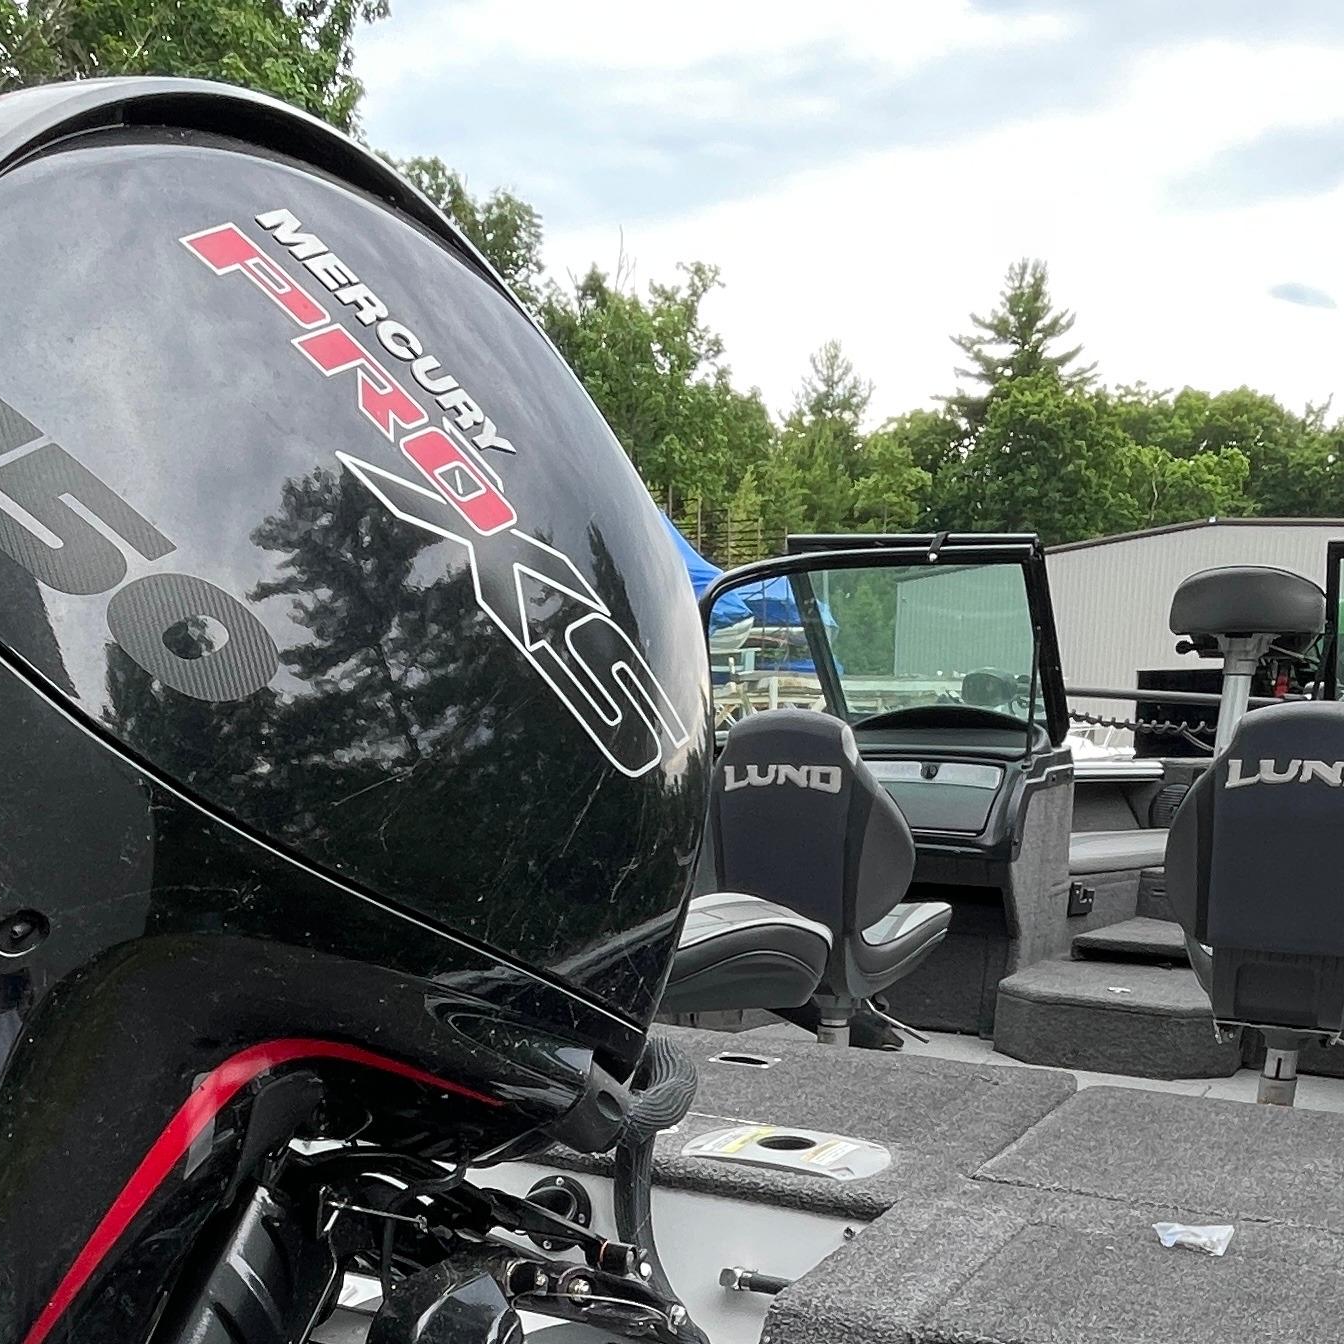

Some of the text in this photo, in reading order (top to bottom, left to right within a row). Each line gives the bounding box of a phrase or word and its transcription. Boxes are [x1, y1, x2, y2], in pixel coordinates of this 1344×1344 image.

[178, 221, 518, 537] PRO
[255, 209, 517, 456] MERCURY
[335, 415, 690, 777] XS
[723, 763, 843, 794] LUND
